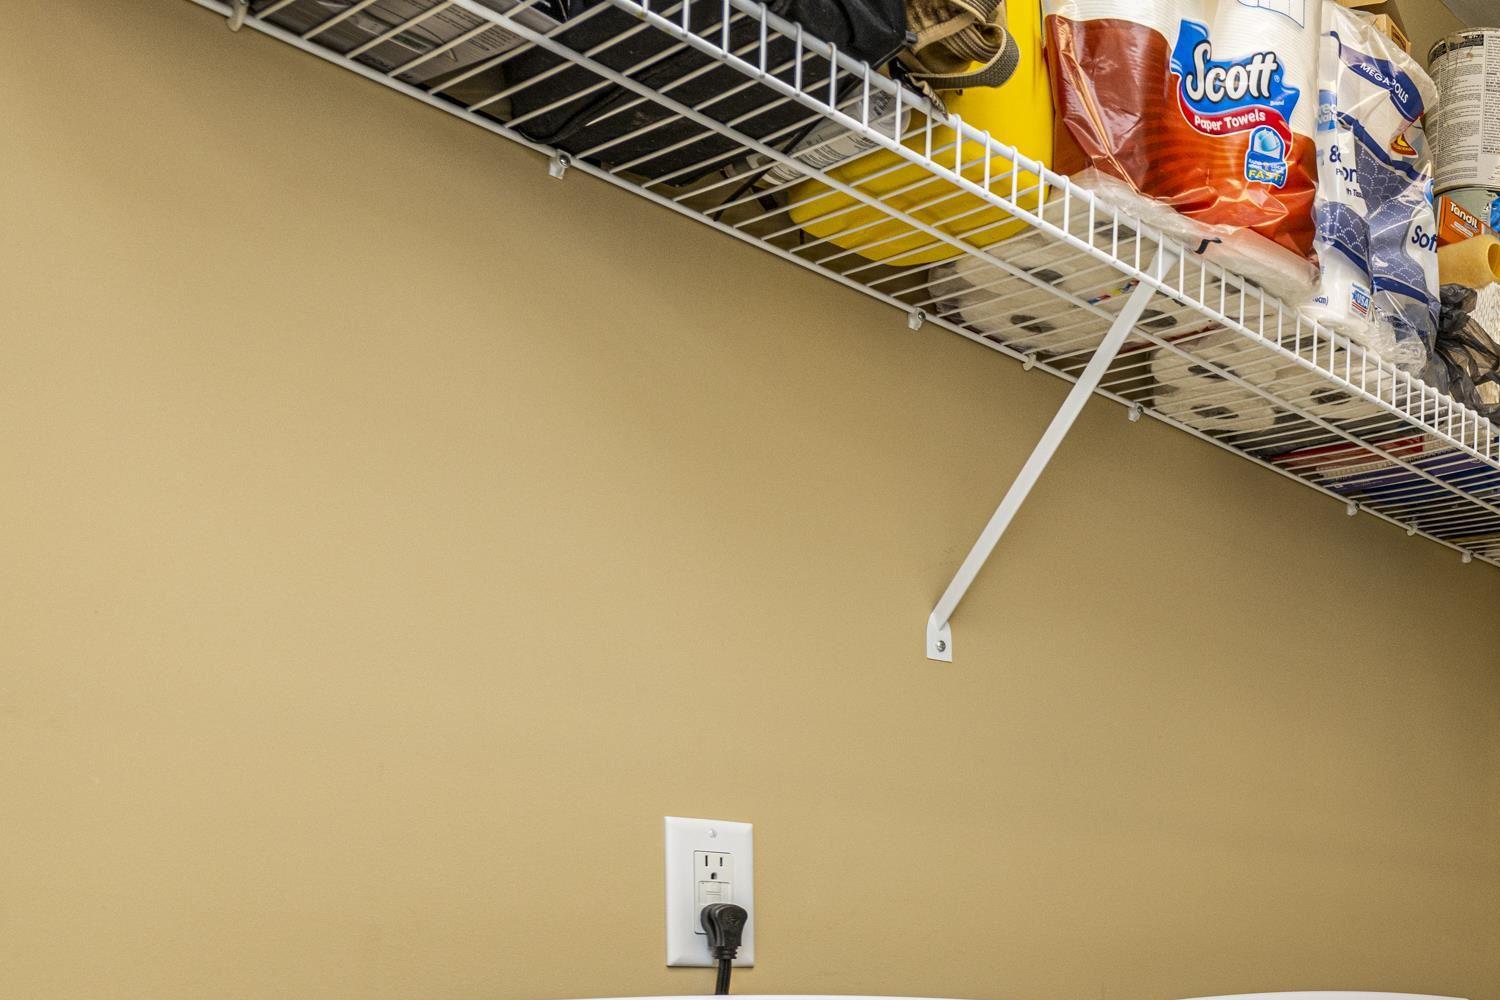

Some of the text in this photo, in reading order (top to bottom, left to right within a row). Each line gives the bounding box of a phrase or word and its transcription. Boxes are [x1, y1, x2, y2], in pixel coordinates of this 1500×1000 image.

[1185, 40, 1279, 103] Scott
[1360, 61, 1390, 84] MEGA
[1194, 109, 1266, 132] Paper Towels
[1449, 201, 1480, 228] Tandil
